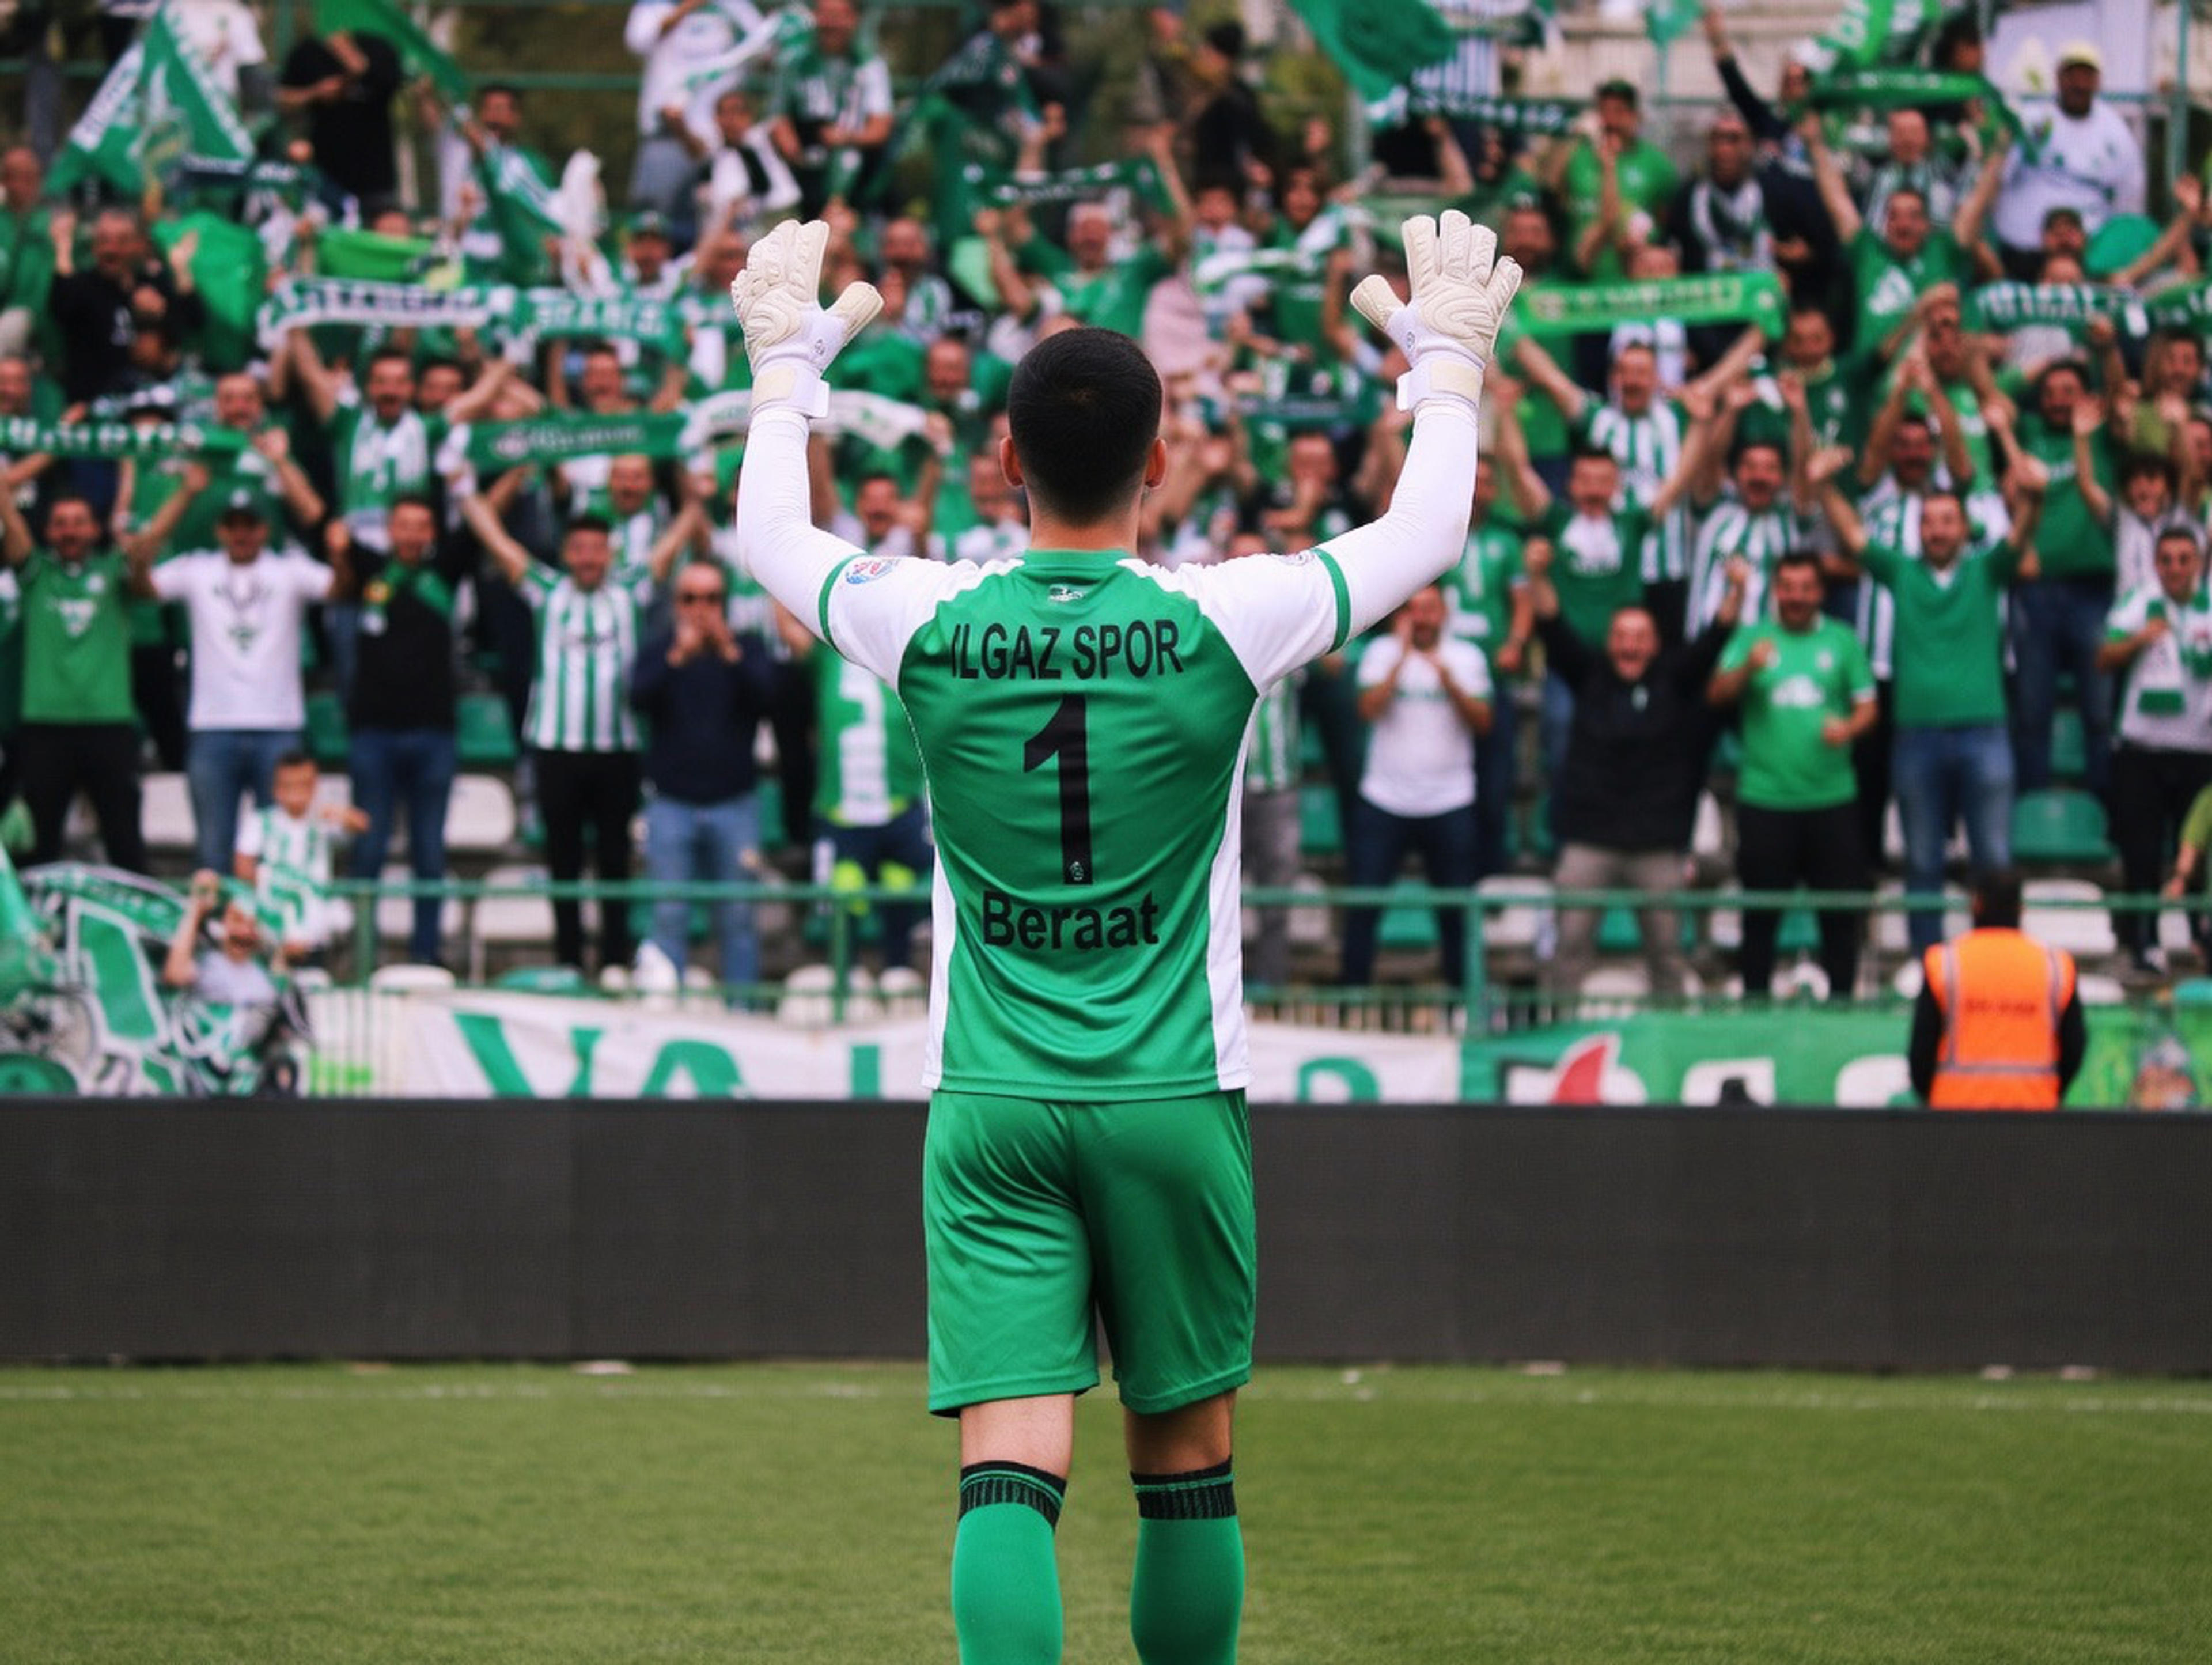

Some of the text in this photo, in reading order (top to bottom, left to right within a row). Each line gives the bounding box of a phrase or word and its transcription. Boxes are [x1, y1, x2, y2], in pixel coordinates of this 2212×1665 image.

[951, 619, 1184, 680] ILGAZ SPOR
[1024, 694, 1093, 886] 1
[983, 889, 1160, 951] Beraat
